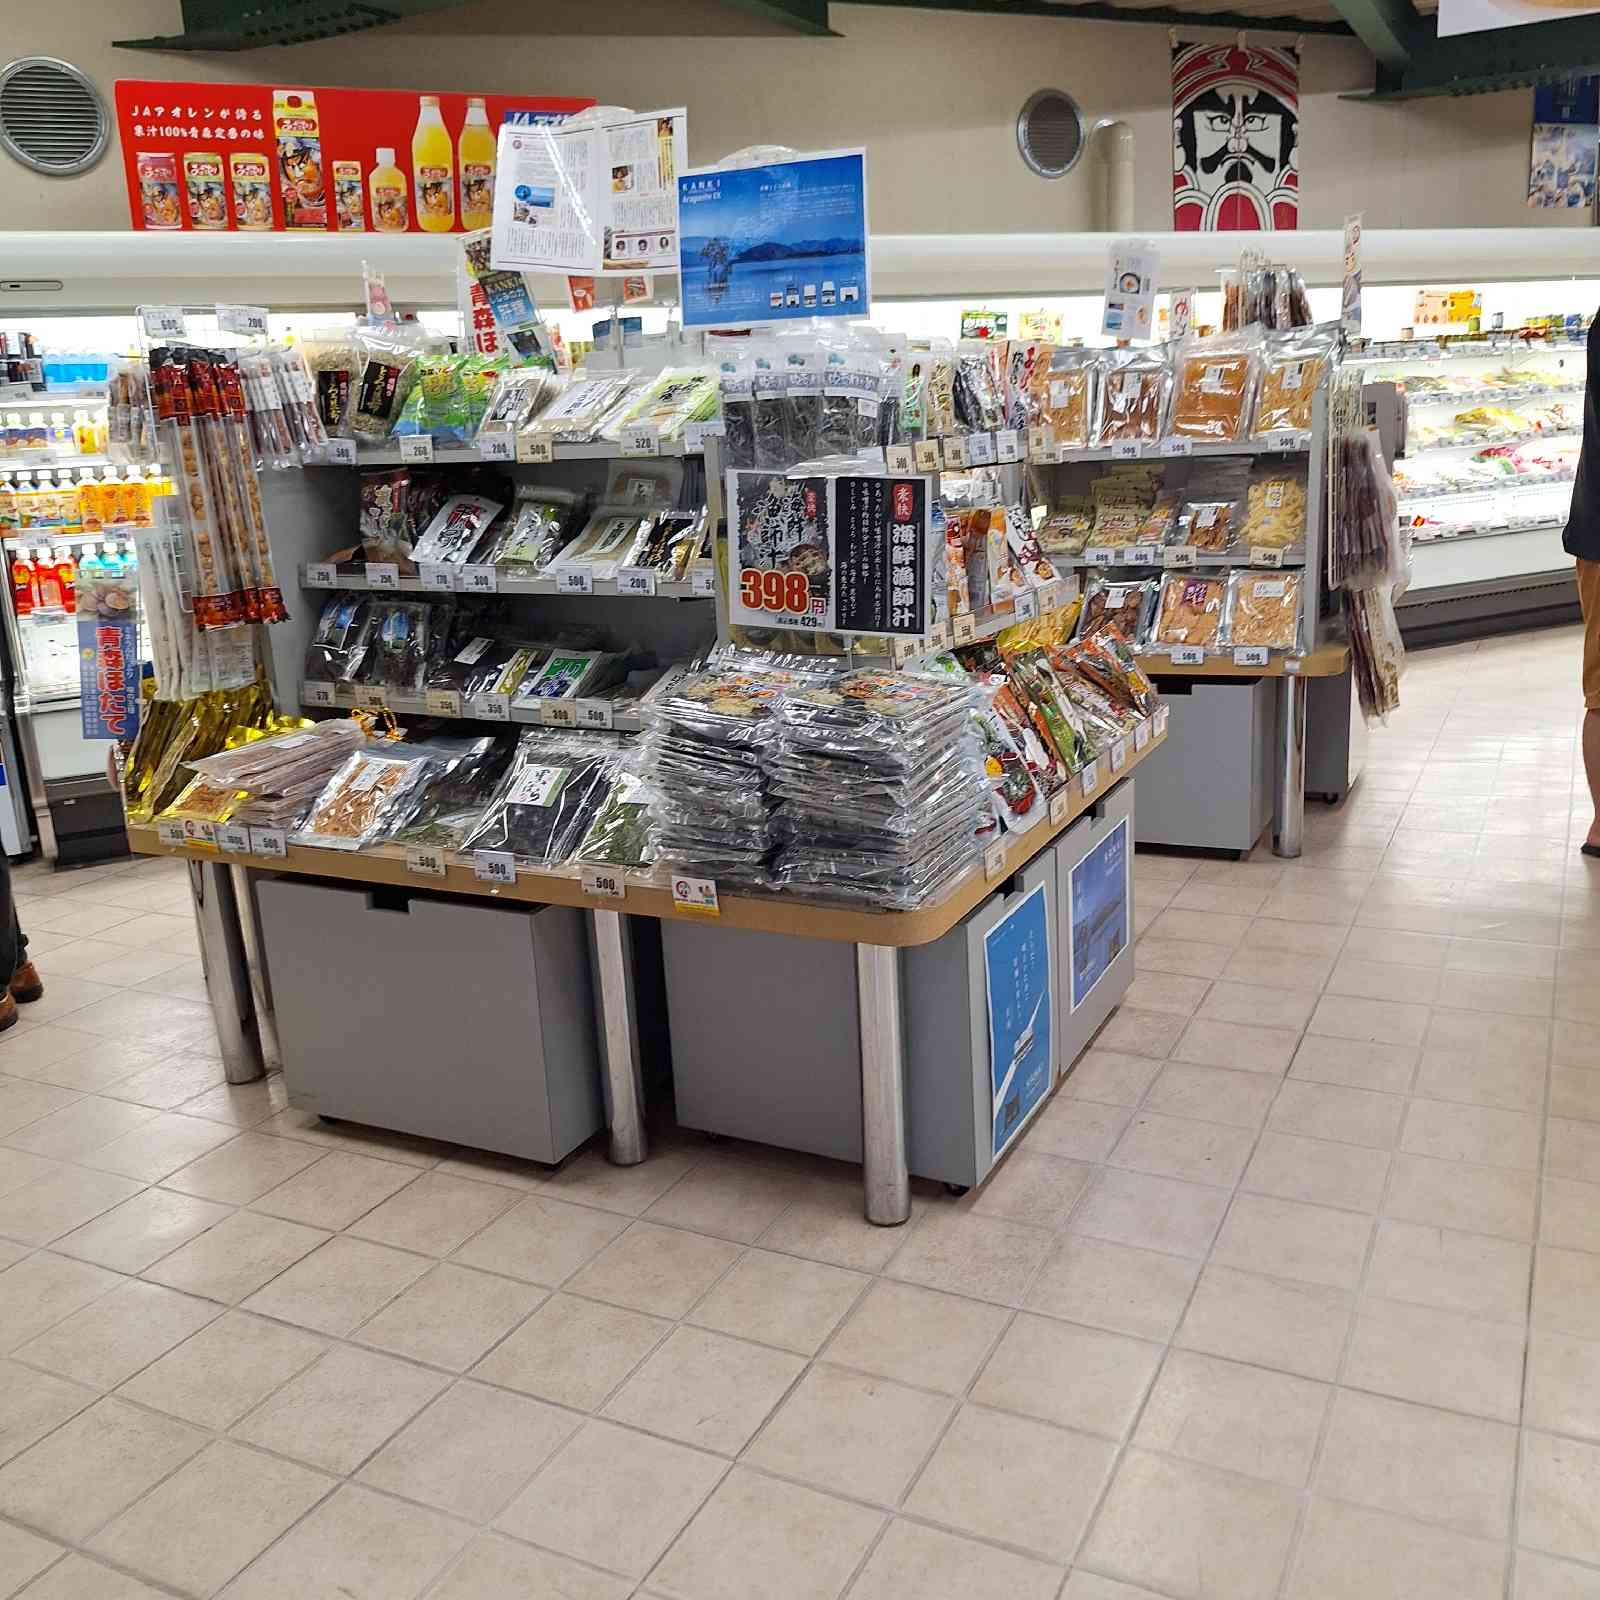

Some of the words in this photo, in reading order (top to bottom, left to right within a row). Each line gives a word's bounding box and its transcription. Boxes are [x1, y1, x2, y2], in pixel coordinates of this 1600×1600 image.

[568, 575, 584, 587] 500
[892, 524, 915, 628] 海鮮漁師汁
[630, 577, 647, 589] 200
[741, 569, 809, 613] 398
[811, 598, 826, 616] 円
[96, 626, 127, 736] 青森ほたて
[587, 710, 604, 722] 500
[418, 856, 436, 868] 500
[488, 863, 506, 875] 500
[596, 876, 615, 890] 500
